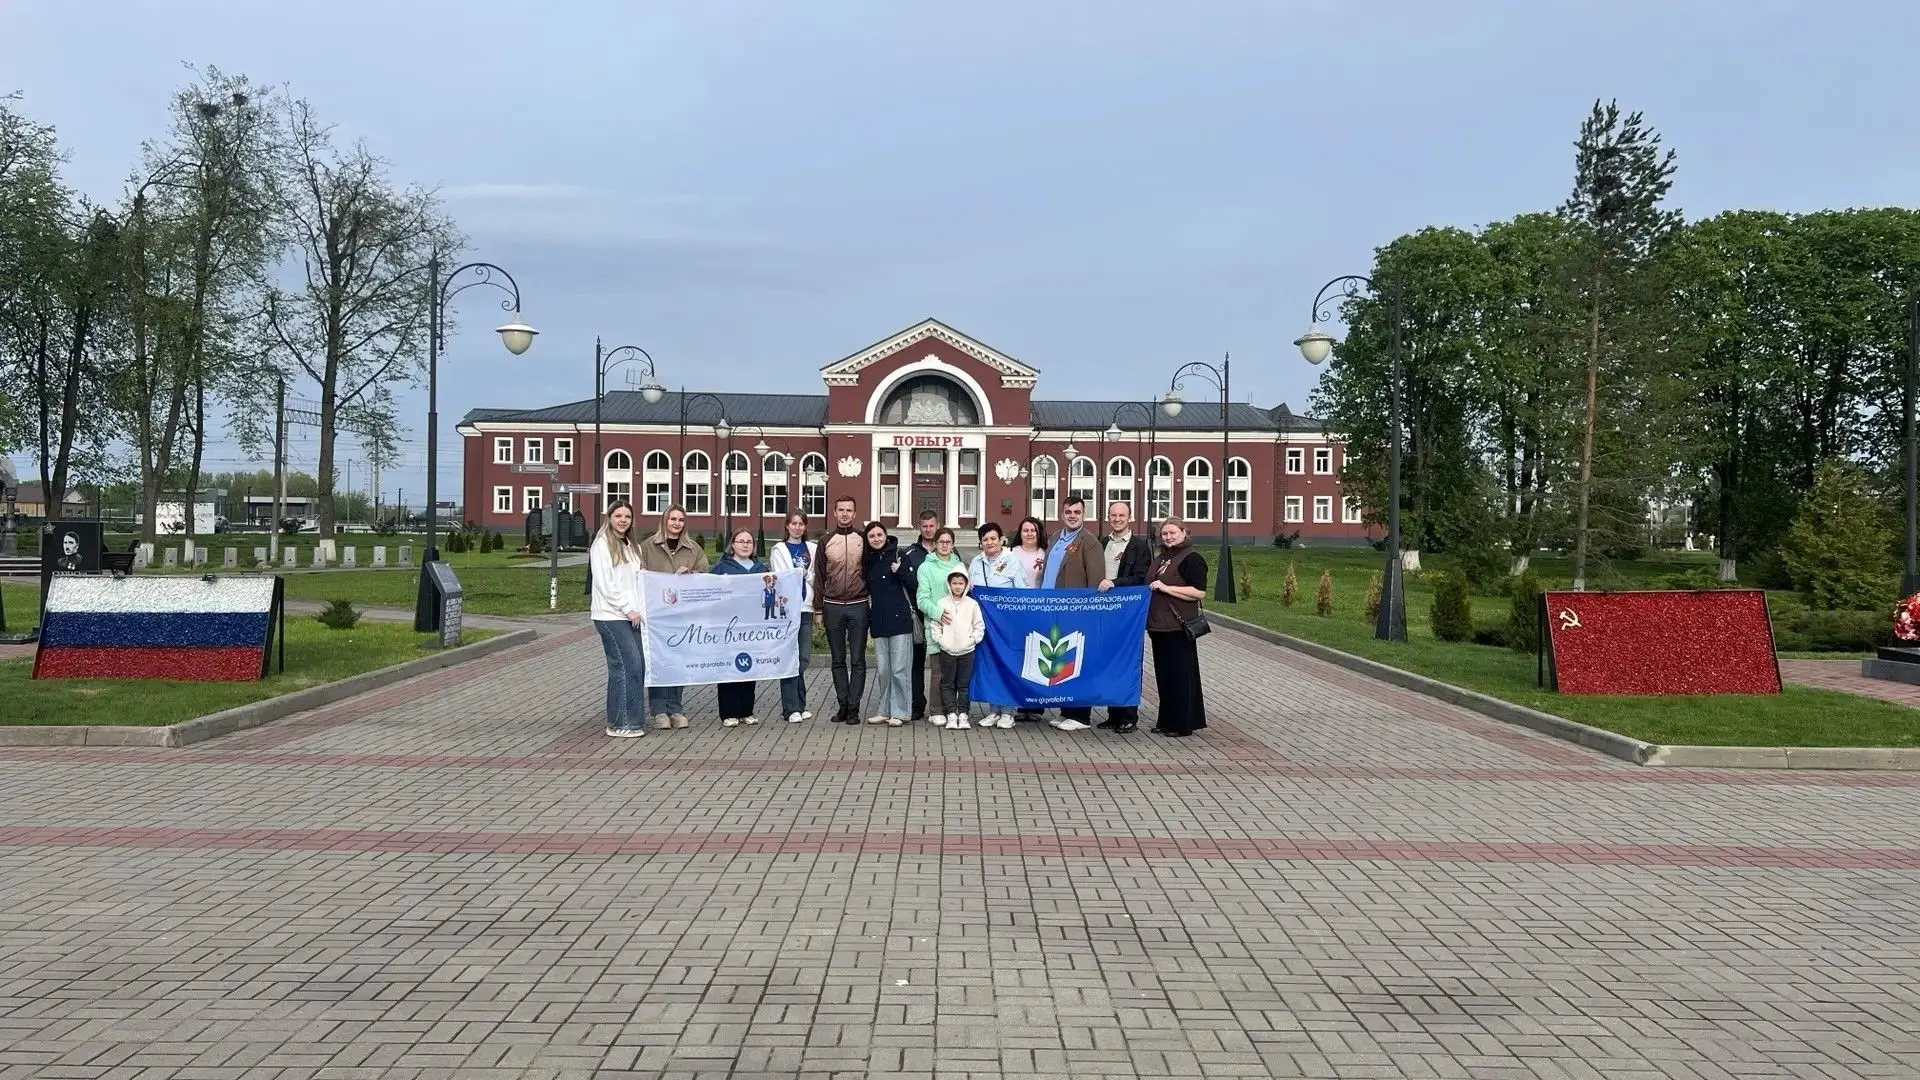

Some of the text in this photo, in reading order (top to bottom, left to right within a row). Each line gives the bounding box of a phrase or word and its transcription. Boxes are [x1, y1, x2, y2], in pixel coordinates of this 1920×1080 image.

[893, 435, 964, 447] ПОНЫРИ
[979, 594, 1045, 604] ОБЩЕРОССИЙСКИЙ
[1089, 594, 1142, 603] ОБРАЗОВАНИЯ
[996, 603, 1122, 612] КУРСКАЯ ГОРОДСКАЯ ОРГАНИЗАЦИЯ
[667, 616, 793, 647] Мы вместе!
